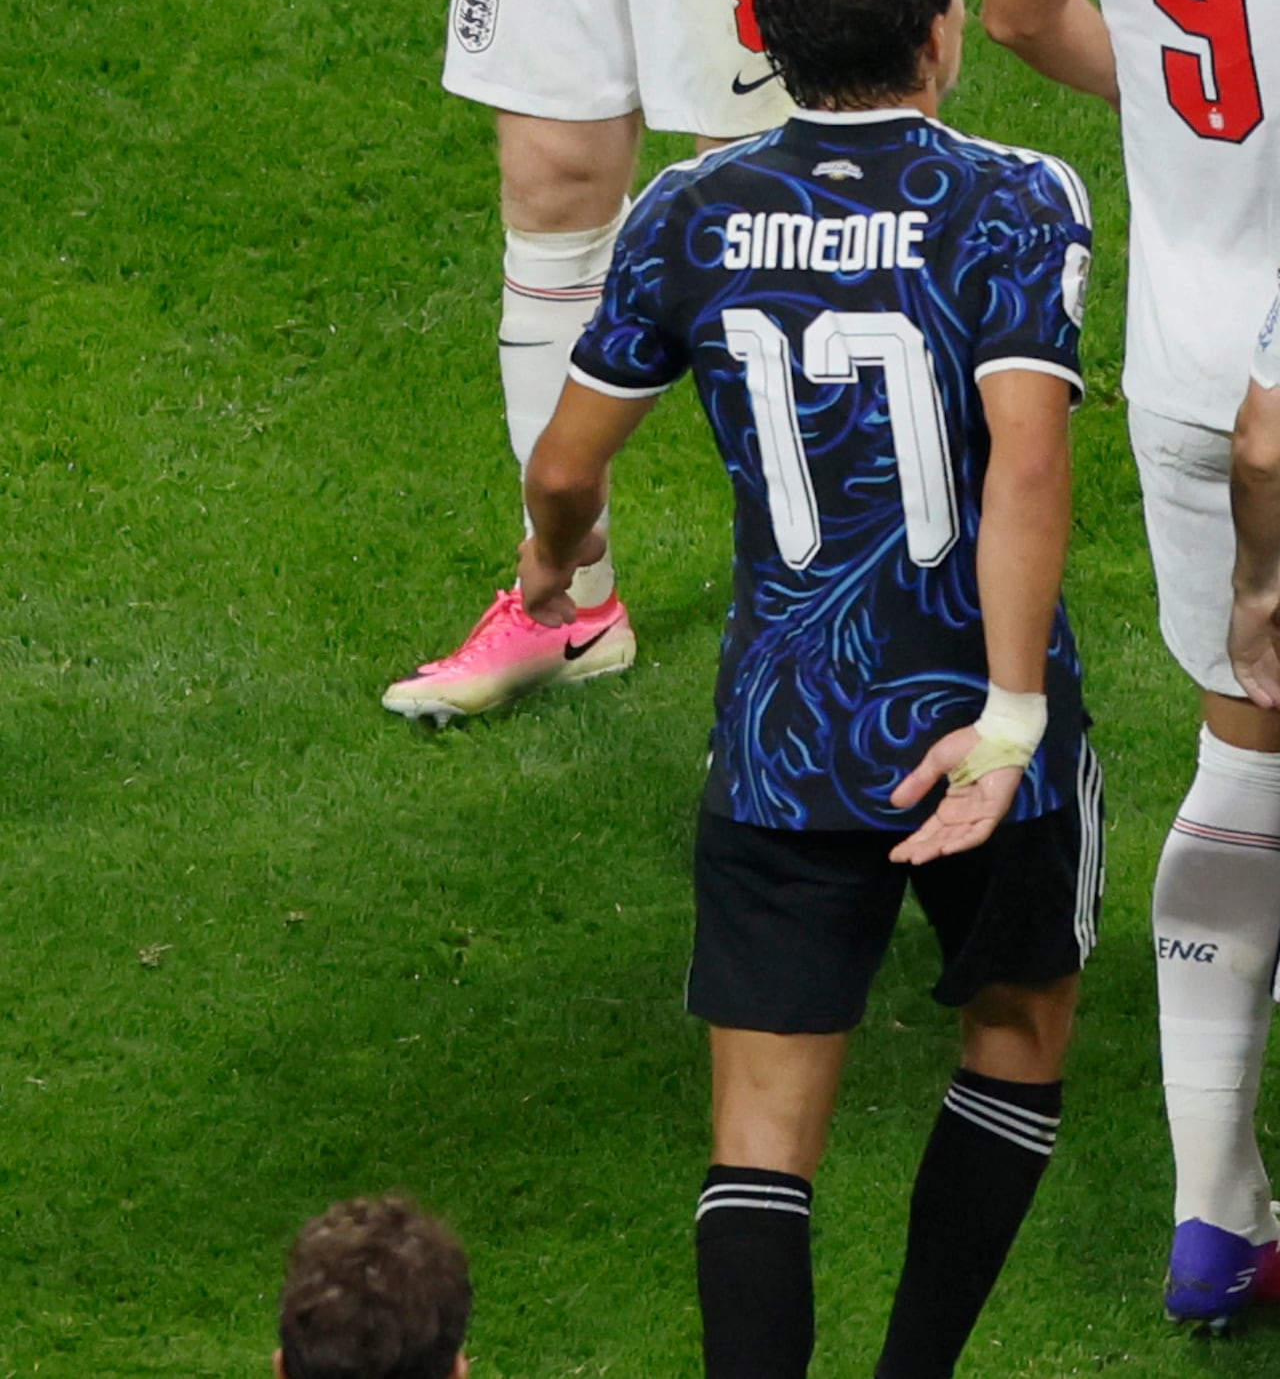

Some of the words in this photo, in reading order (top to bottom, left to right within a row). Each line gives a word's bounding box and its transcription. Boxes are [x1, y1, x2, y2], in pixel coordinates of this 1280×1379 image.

[723, 210, 929, 271] SIMEONE
[721, 308, 961, 570] 17
[1158, 935, 1219, 964] ENG
